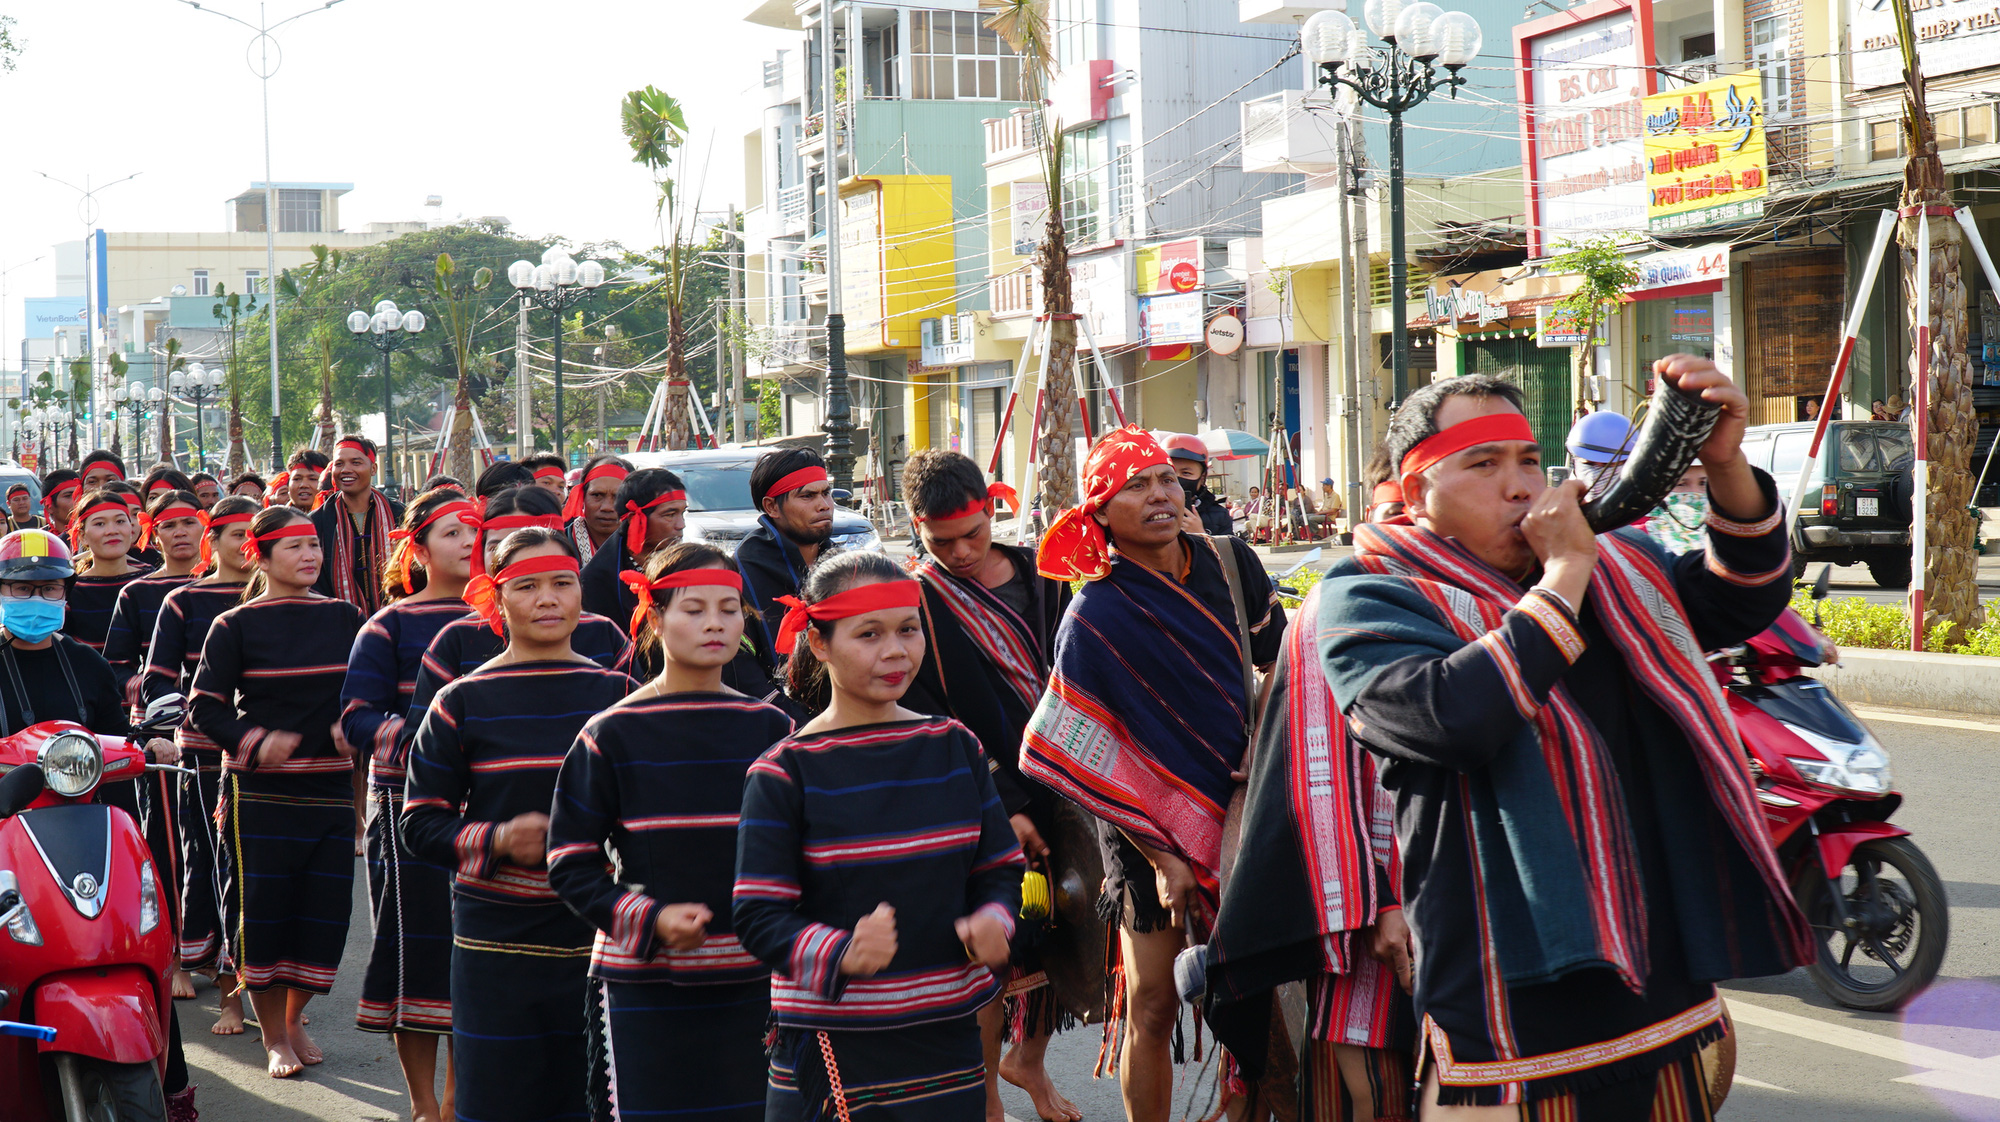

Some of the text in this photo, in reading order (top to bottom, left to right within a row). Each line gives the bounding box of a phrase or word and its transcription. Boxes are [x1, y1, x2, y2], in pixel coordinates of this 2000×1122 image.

[1920, 20, 1959, 41] HIỆP
[1559, 64, 1619, 103] BS. CKI
[1538, 86, 1643, 160] KIM PHÚ
[1681, 91, 1714, 134] 44
[1674, 141, 1719, 172] QUẢNG
[1714, 169, 1734, 195] GÀ
[1697, 252, 1727, 276] 44
[36, 314, 79, 323] VietinBank
[1210, 327, 1236, 339] Jetstar
